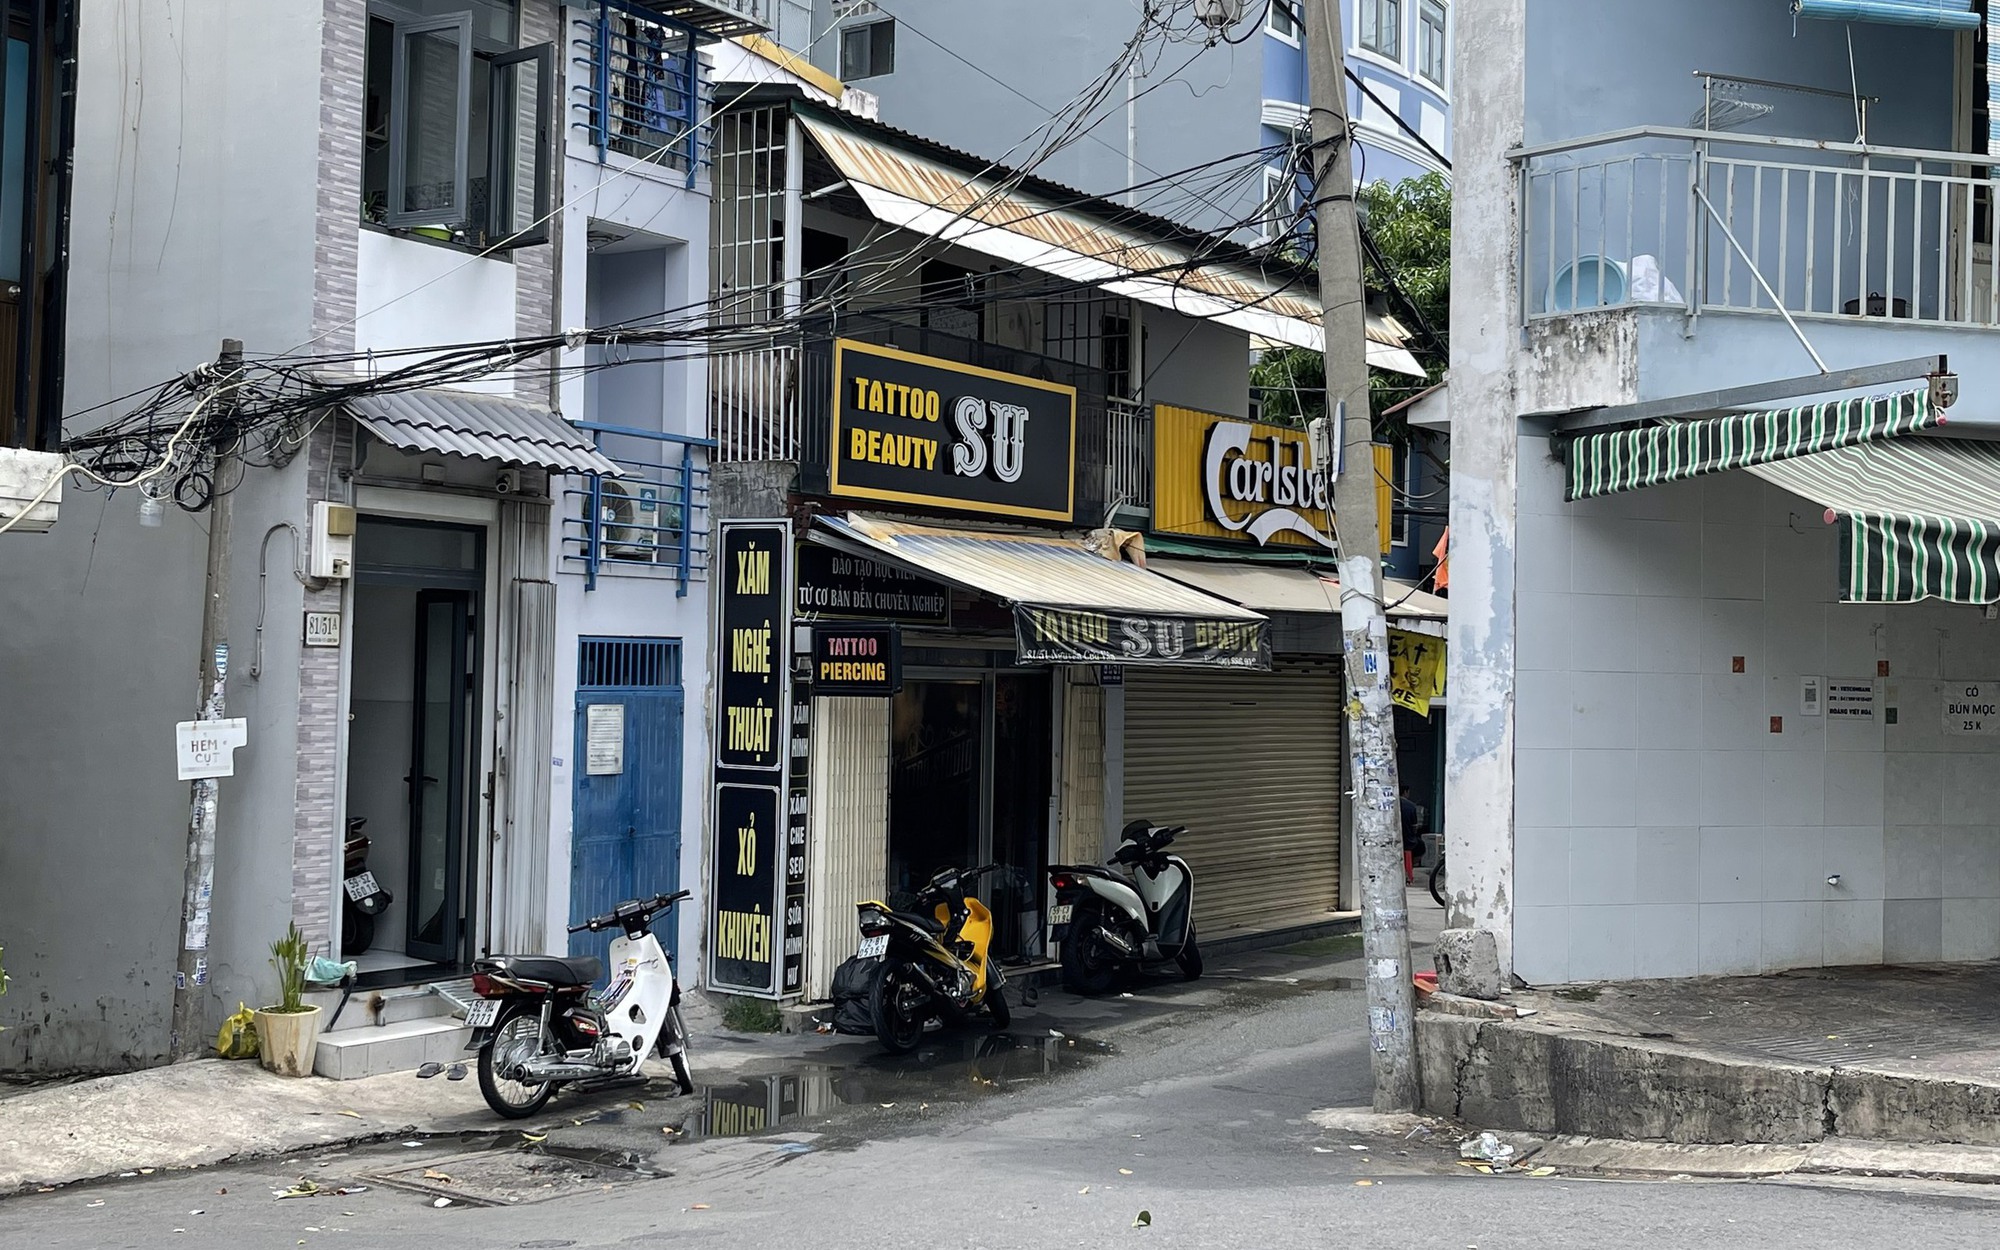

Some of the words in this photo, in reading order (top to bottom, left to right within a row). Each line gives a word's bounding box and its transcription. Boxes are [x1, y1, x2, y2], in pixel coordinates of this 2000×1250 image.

[855, 377, 940, 423] TATTOO
[850, 427, 938, 471] BEAUTY
[953, 395, 1030, 484] SU
[1206, 421, 1336, 530] Carlsbe
[736, 541, 770, 595] XĂM
[832, 552, 851, 576] ĐÀO
[854, 559, 872, 581] TẠO
[799, 582, 814, 605] TỪ
[815, 587, 828, 606] CƠ
[831, 584, 850, 608] BẢN
[853, 582, 872, 609] ĐẾN
[874, 591, 910, 612] CHUYÊN
[912, 592, 945, 616] NGHIỆP
[828, 638, 877, 656] TATTOO
[1032, 609, 1109, 644] TATTOO
[1119, 615, 1187, 659] SU
[732, 619, 771, 683] NGHỆ
[821, 662, 886, 681] PIERCING
[1965, 684, 1979, 697] CÓ
[792, 701, 809, 724] XĂM
[1949, 701, 1970, 715] BÚN
[1972, 704, 1996, 717] MỌC
[728, 698, 773, 762] THUẬT
[1963, 720, 1974, 731] 25
[1975, 720, 1982, 731] K
[789, 793, 808, 815] XĂM
[737, 812, 757, 877] XỎ
[790, 826, 805, 845] CHE
[789, 856, 804, 879] SẸO
[787, 901, 802, 926] SỬA
[718, 904, 771, 963] KHUYÊN
[787, 965, 799, 986] HƯ
[467, 1013, 492, 1025] 2273
